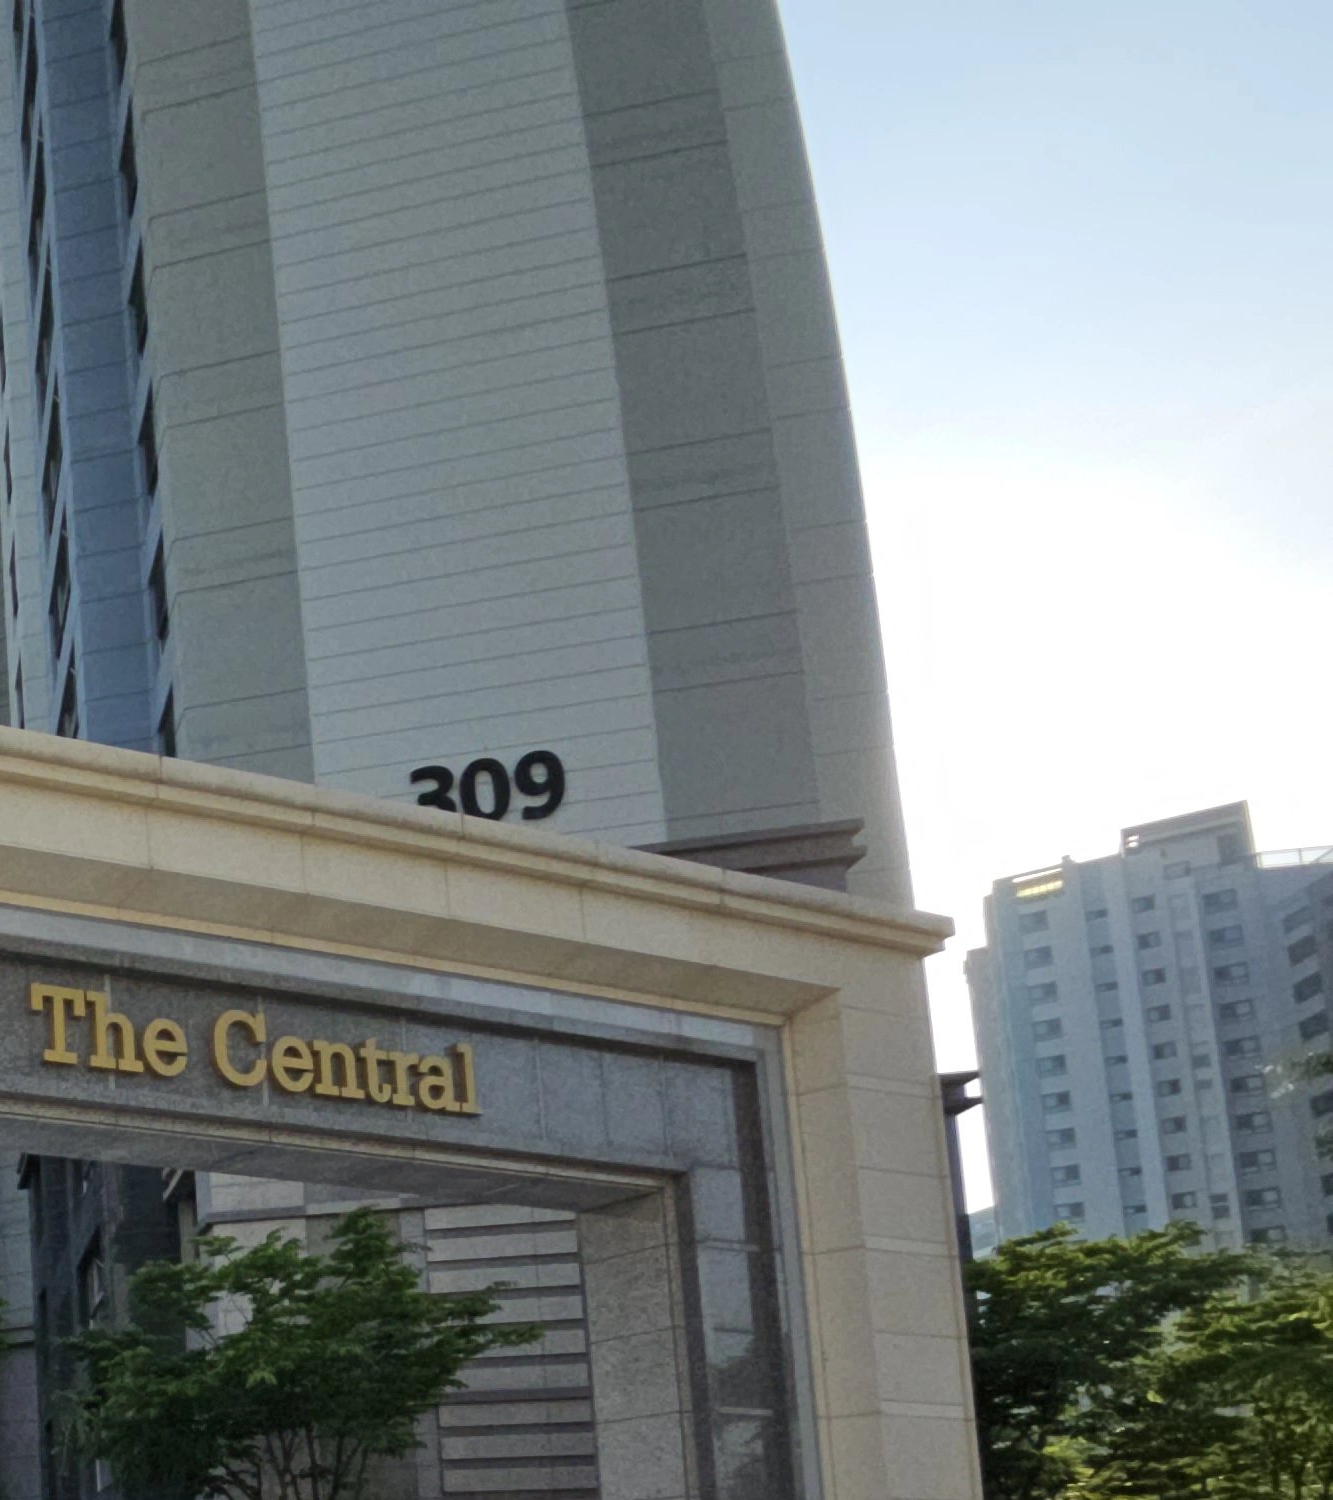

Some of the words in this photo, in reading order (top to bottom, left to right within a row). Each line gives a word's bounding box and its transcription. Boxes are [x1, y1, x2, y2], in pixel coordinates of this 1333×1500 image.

[410, 750, 565, 821] 309
[30, 982, 188, 1077] The
[213, 1009, 481, 1115] Central
